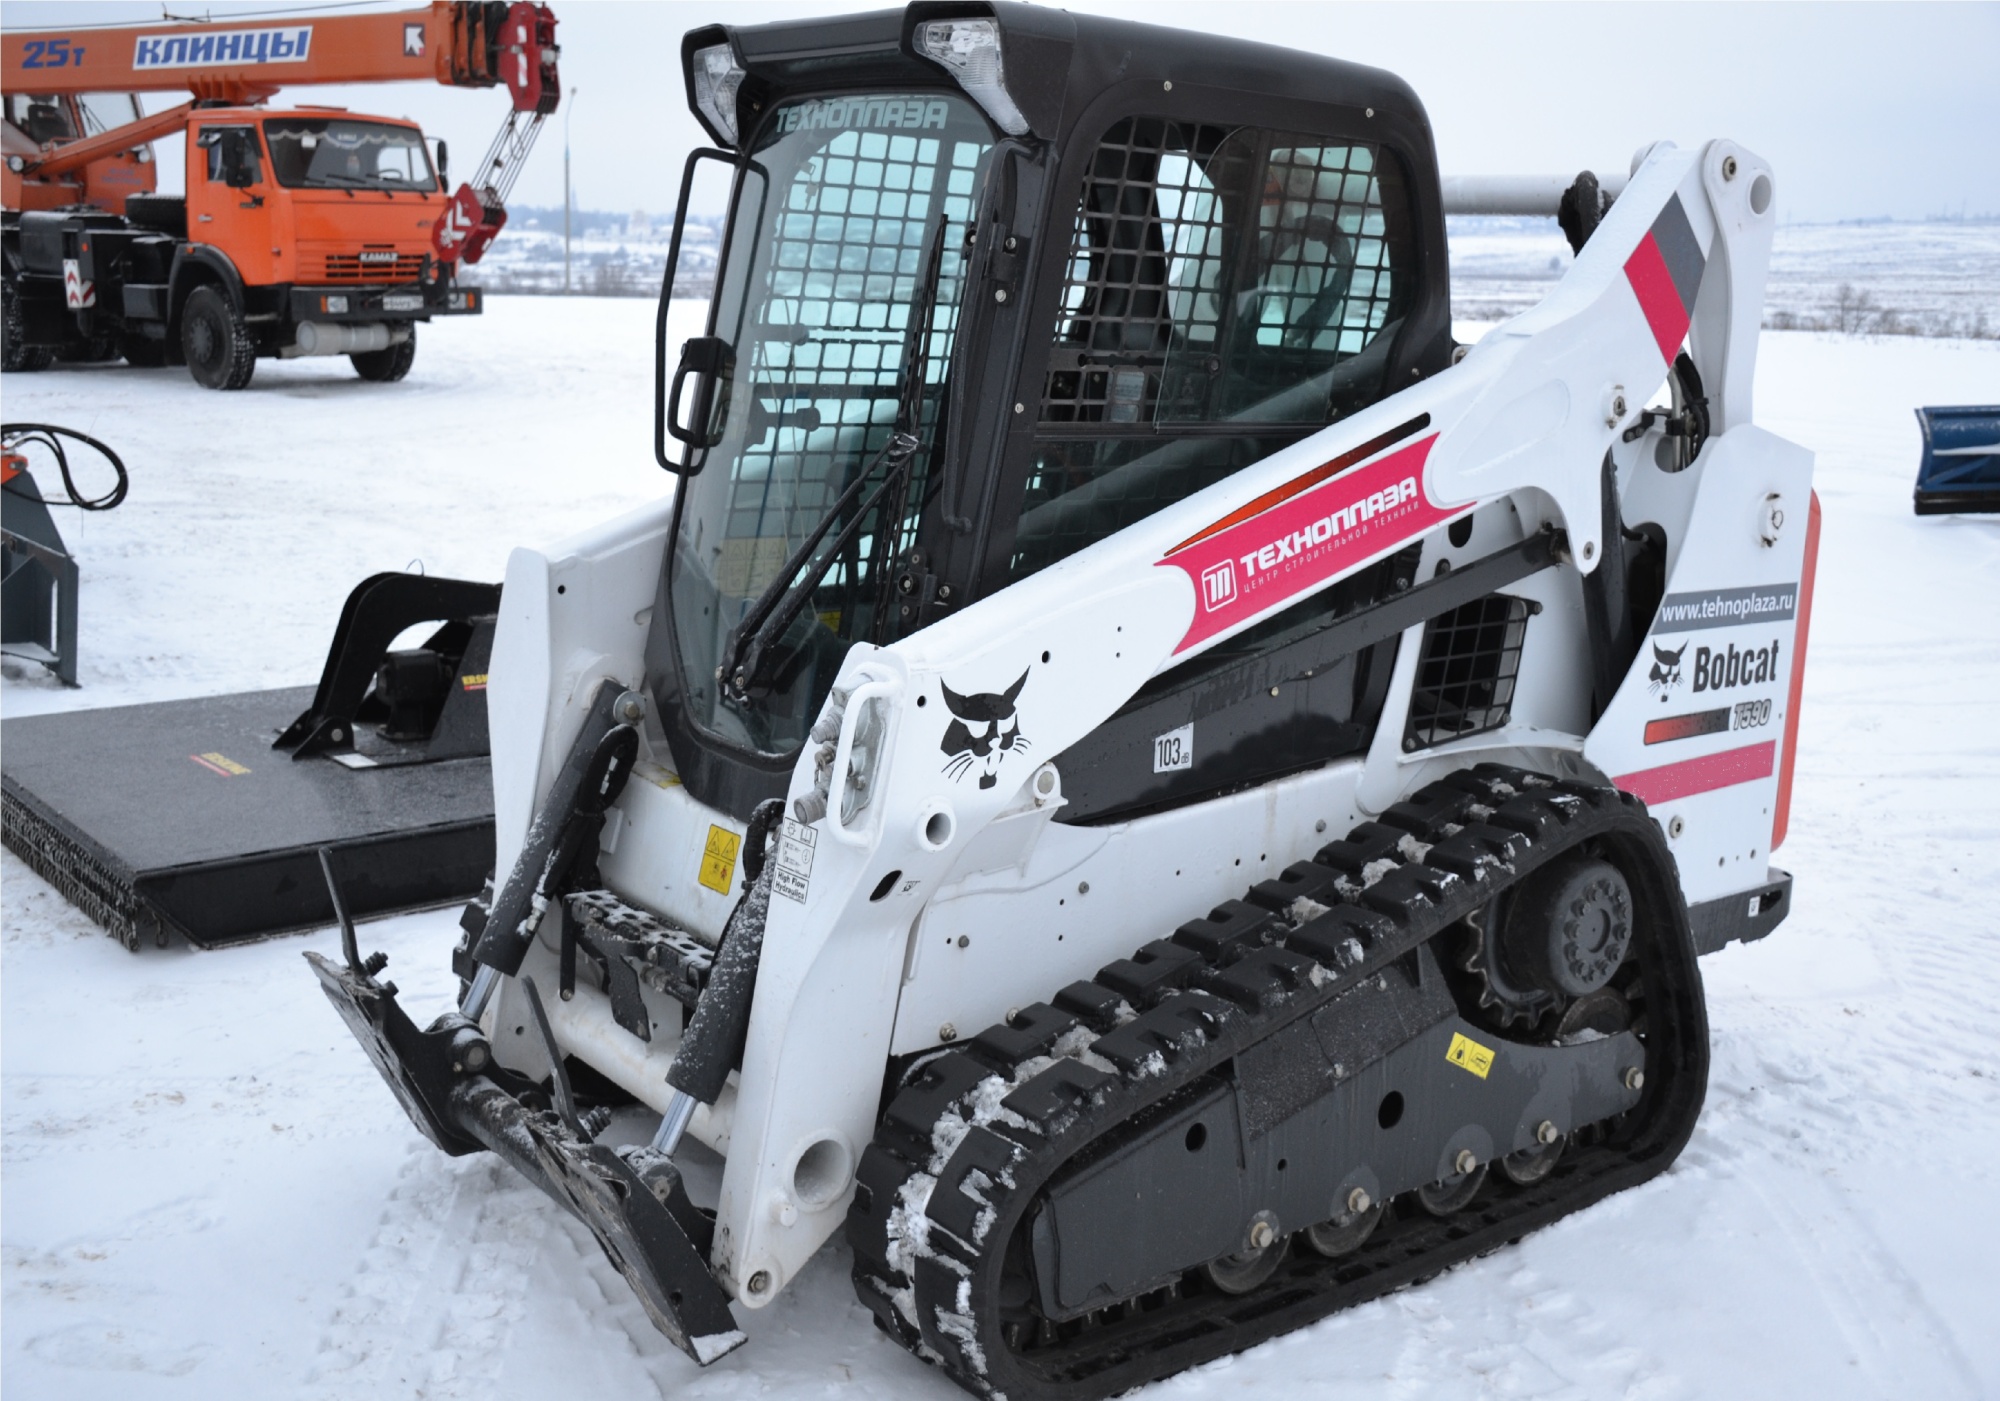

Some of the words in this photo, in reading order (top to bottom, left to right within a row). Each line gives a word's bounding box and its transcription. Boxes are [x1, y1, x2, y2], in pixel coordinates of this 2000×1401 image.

[136, 30, 309, 65] КЛИНЦЫ
[1239, 476, 1418, 578] ТЕХНОПЛАЗА
[1243, 569, 1278, 594] ЦЕНТР
[1285, 525, 1368, 573] СТРОИТЕЛЬНОЙ
[1374, 500, 1419, 529] ТЕХНИКИ
[1661, 593, 1794, 622] www.tehnoplaza.ru
[1692, 639, 1779, 693] Bobcat
[1732, 699, 1772, 731] T590
[1158, 737, 1181, 767] 103
[1181, 751, 1190, 764] dB
[775, 880, 805, 900] Hydraulics
[777, 871, 791, 883] High
[791, 877, 806, 889] Flow
